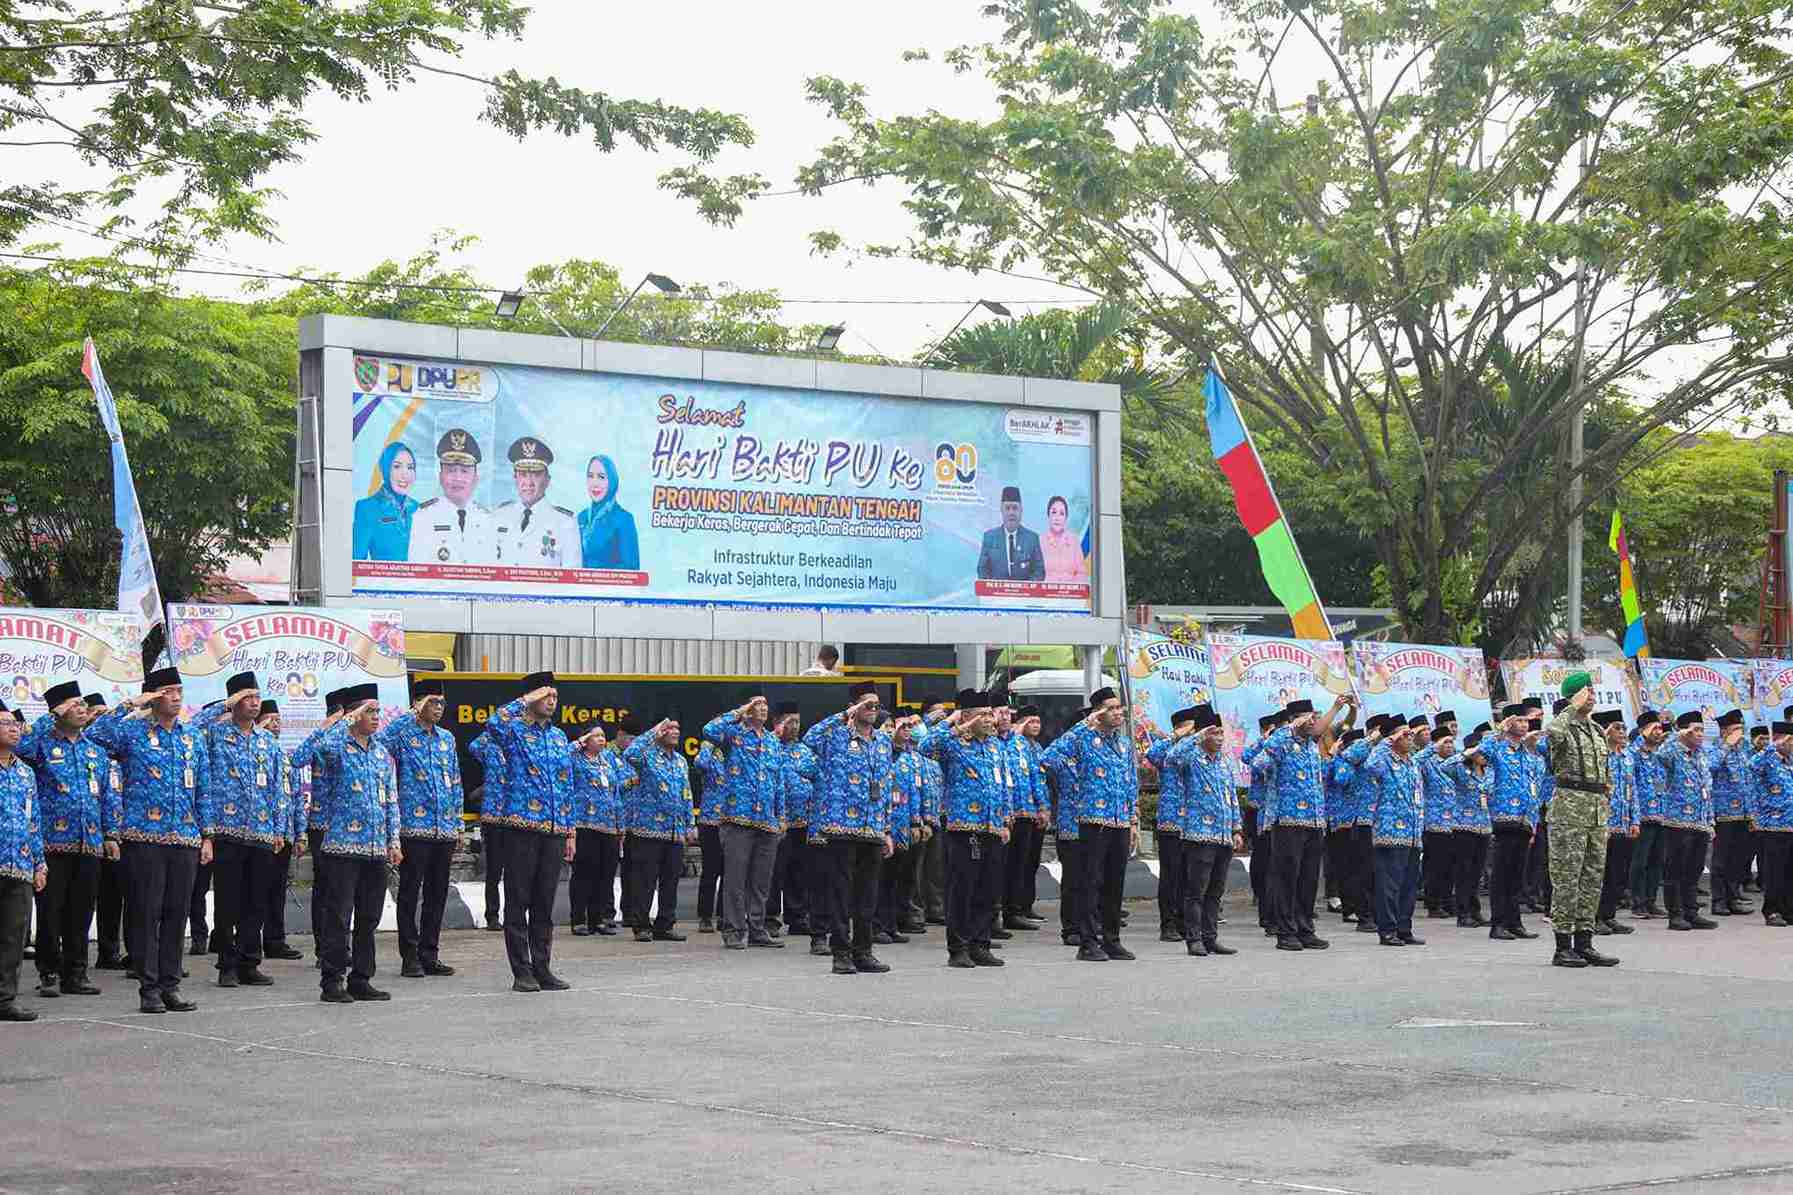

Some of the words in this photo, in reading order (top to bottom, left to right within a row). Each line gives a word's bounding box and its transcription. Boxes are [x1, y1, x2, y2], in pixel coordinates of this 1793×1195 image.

[657, 394, 746, 428] Selamat
[651, 427, 728, 480] Hari
[730, 435, 821, 486] Bakti
[824, 440, 883, 488] PU
[935, 441, 977, 484] 80
[653, 486, 737, 513] PROVINSI
[738, 490, 853, 519] KALIMANTAN
[855, 496, 921, 523] TENGAH
[652, 511, 696, 533] Bekerja
[733, 516, 783, 535] Bergerak
[841, 520, 893, 539] Bertindak
[713, 548, 795, 566] Infrastruktur
[799, 552, 873, 569] Berkeadilan
[687, 568, 733, 587] Rakyat
[737, 570, 801, 589] Sejahtera,
[804, 573, 865, 590] Indonesia
[868, 575, 897, 592] Maju
[0, 614, 82, 650] AMAT
[223, 616, 350, 648] SELAMAT
[232, 649, 271, 672] Hari
[274, 650, 319, 673] Bakti
[322, 650, 352, 673] PU
[1240, 642, 1313, 669] SELAMAT
[1386, 652, 1456, 673] SELAMAT
[1667, 666, 1729, 687] SELAMAT
